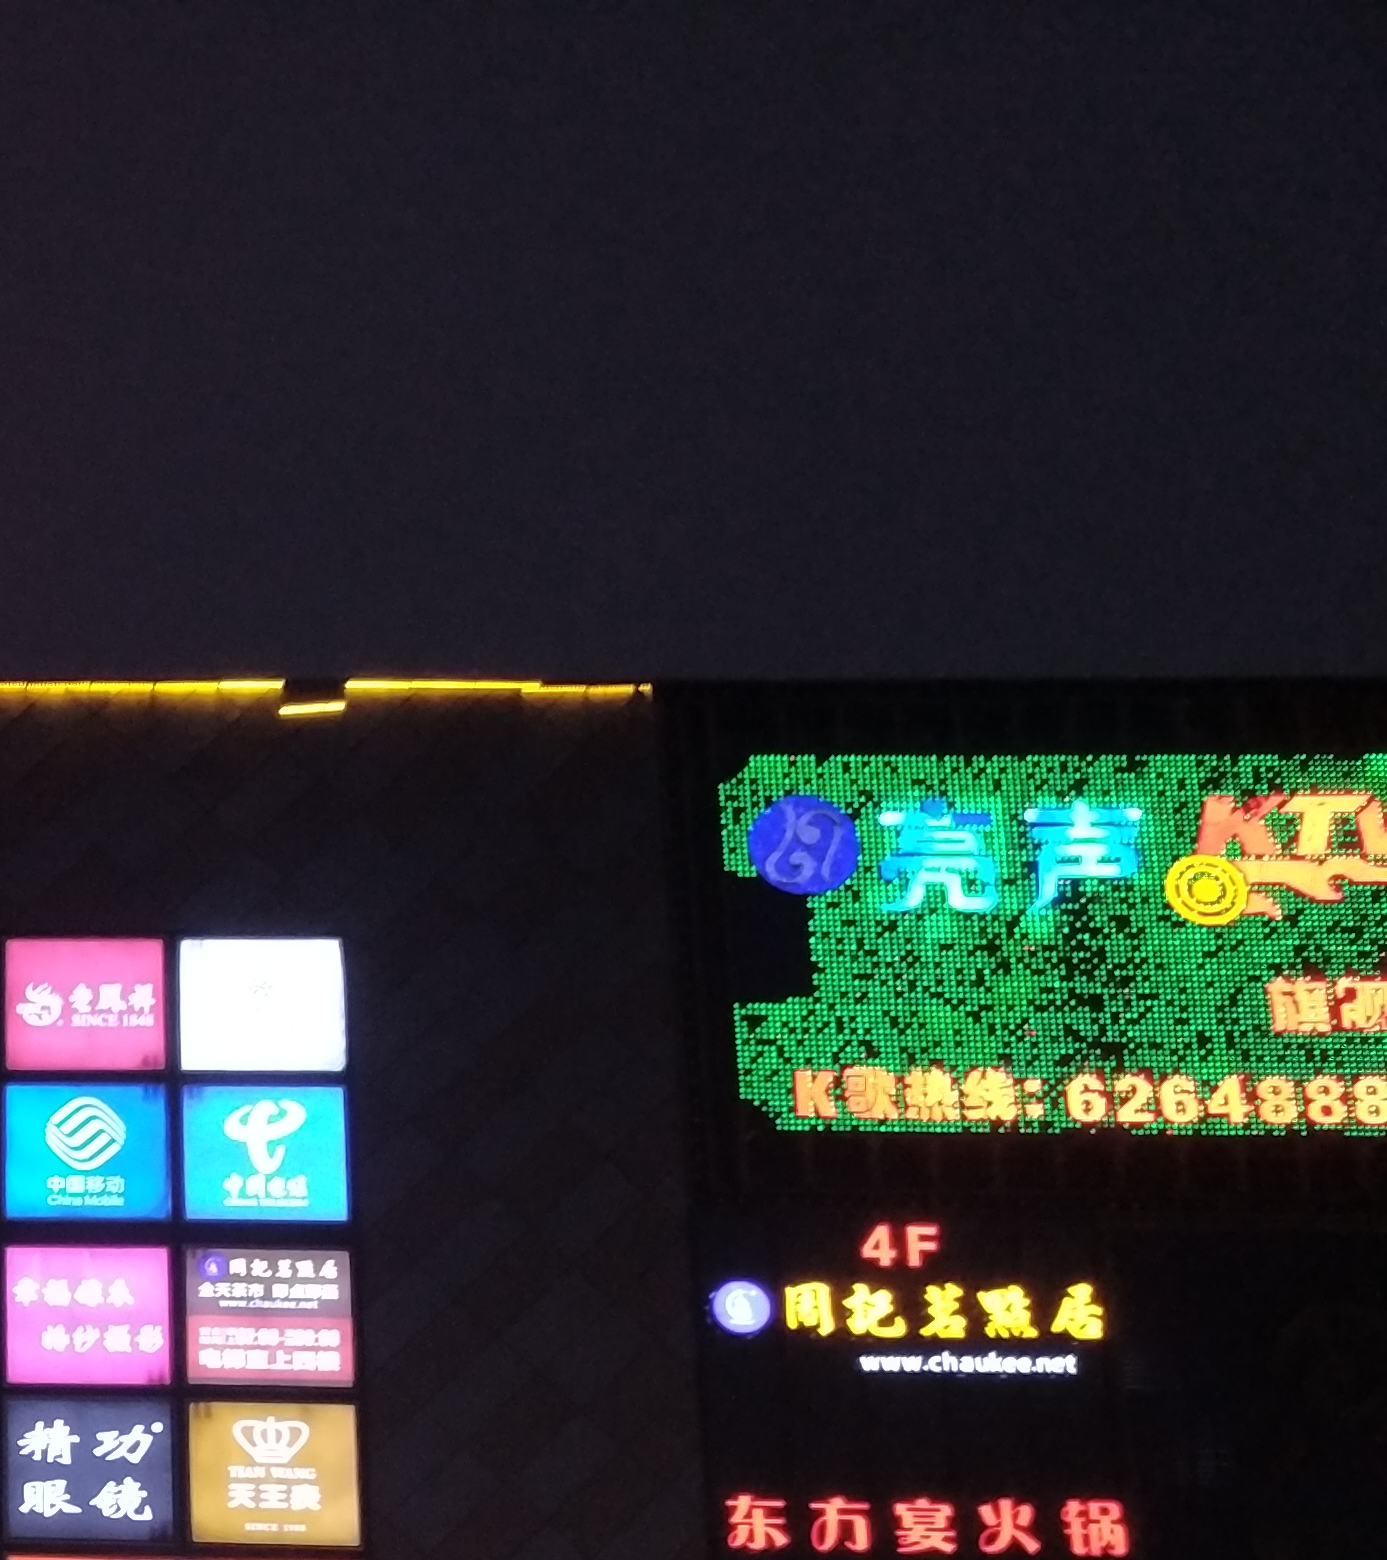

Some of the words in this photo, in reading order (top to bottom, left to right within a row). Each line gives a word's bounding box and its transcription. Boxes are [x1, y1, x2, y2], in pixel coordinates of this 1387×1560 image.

[878, 798, 1142, 913] 亮声
[46, 1174, 125, 1194] 中国移动
[860, 1222, 940, 1268] 4F
[858, 1351, 1079, 1376] www.chaukee.net
[16, 1417, 155, 1466] 精功
[17, 1475, 155, 1522] 眼镜
[725, 1493, 1131, 1558] 东方宴火锅
